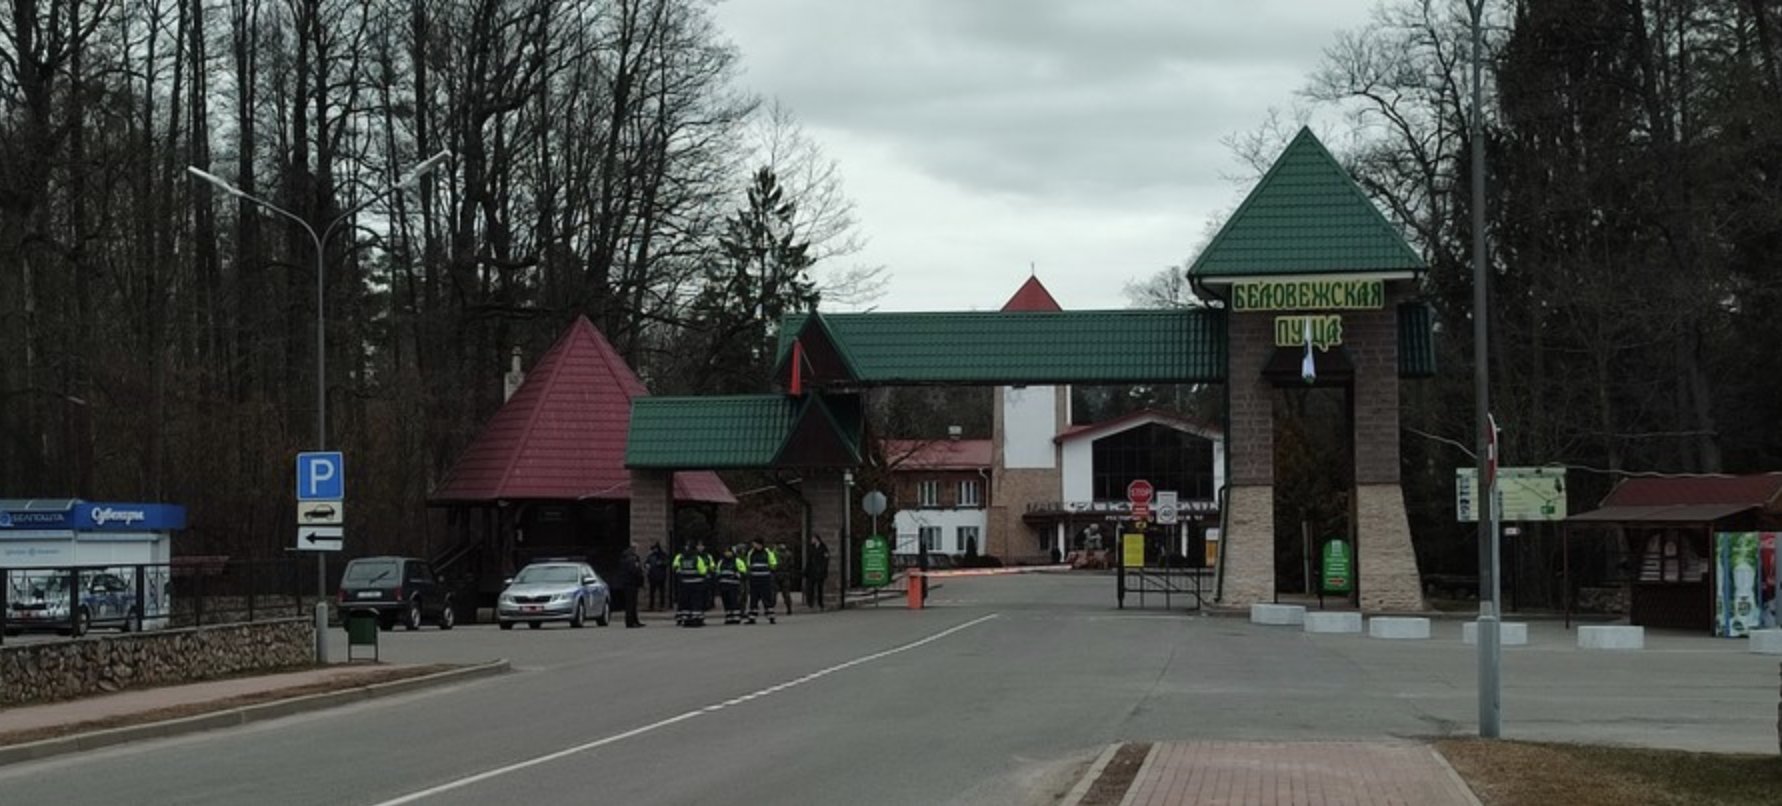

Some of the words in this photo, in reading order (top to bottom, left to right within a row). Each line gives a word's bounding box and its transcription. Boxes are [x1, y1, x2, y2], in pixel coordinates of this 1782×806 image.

[1234, 281, 1382, 309] БЕЛОВЕЖСКАЯ
[310, 459, 334, 495] P
[1131, 487, 1149, 497] STOP
[91, 507, 145, 525] Сувениры
